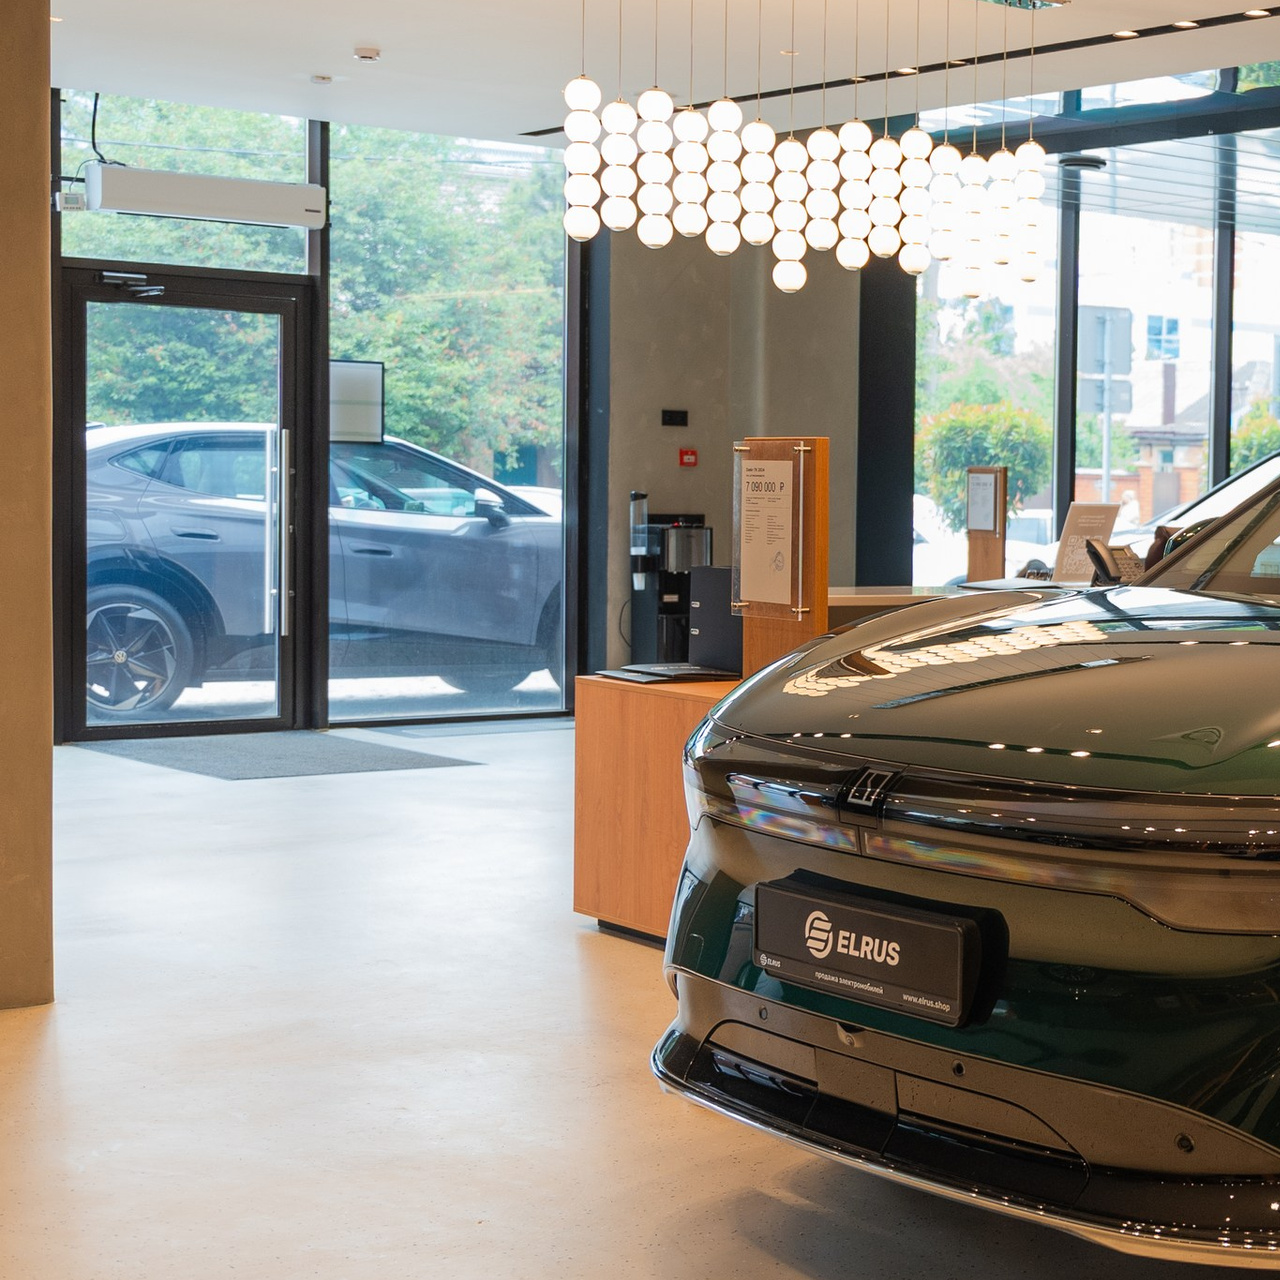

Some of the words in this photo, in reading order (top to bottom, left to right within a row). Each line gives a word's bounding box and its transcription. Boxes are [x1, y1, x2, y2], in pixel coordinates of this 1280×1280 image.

[837, 930, 900, 966] ELRUS
[767, 958, 781, 967] ELRUS
[814, 971, 839, 983] продажа
[838, 977, 884, 995] электромобилей
[902, 993, 951, 1012] www.elrus.shop
